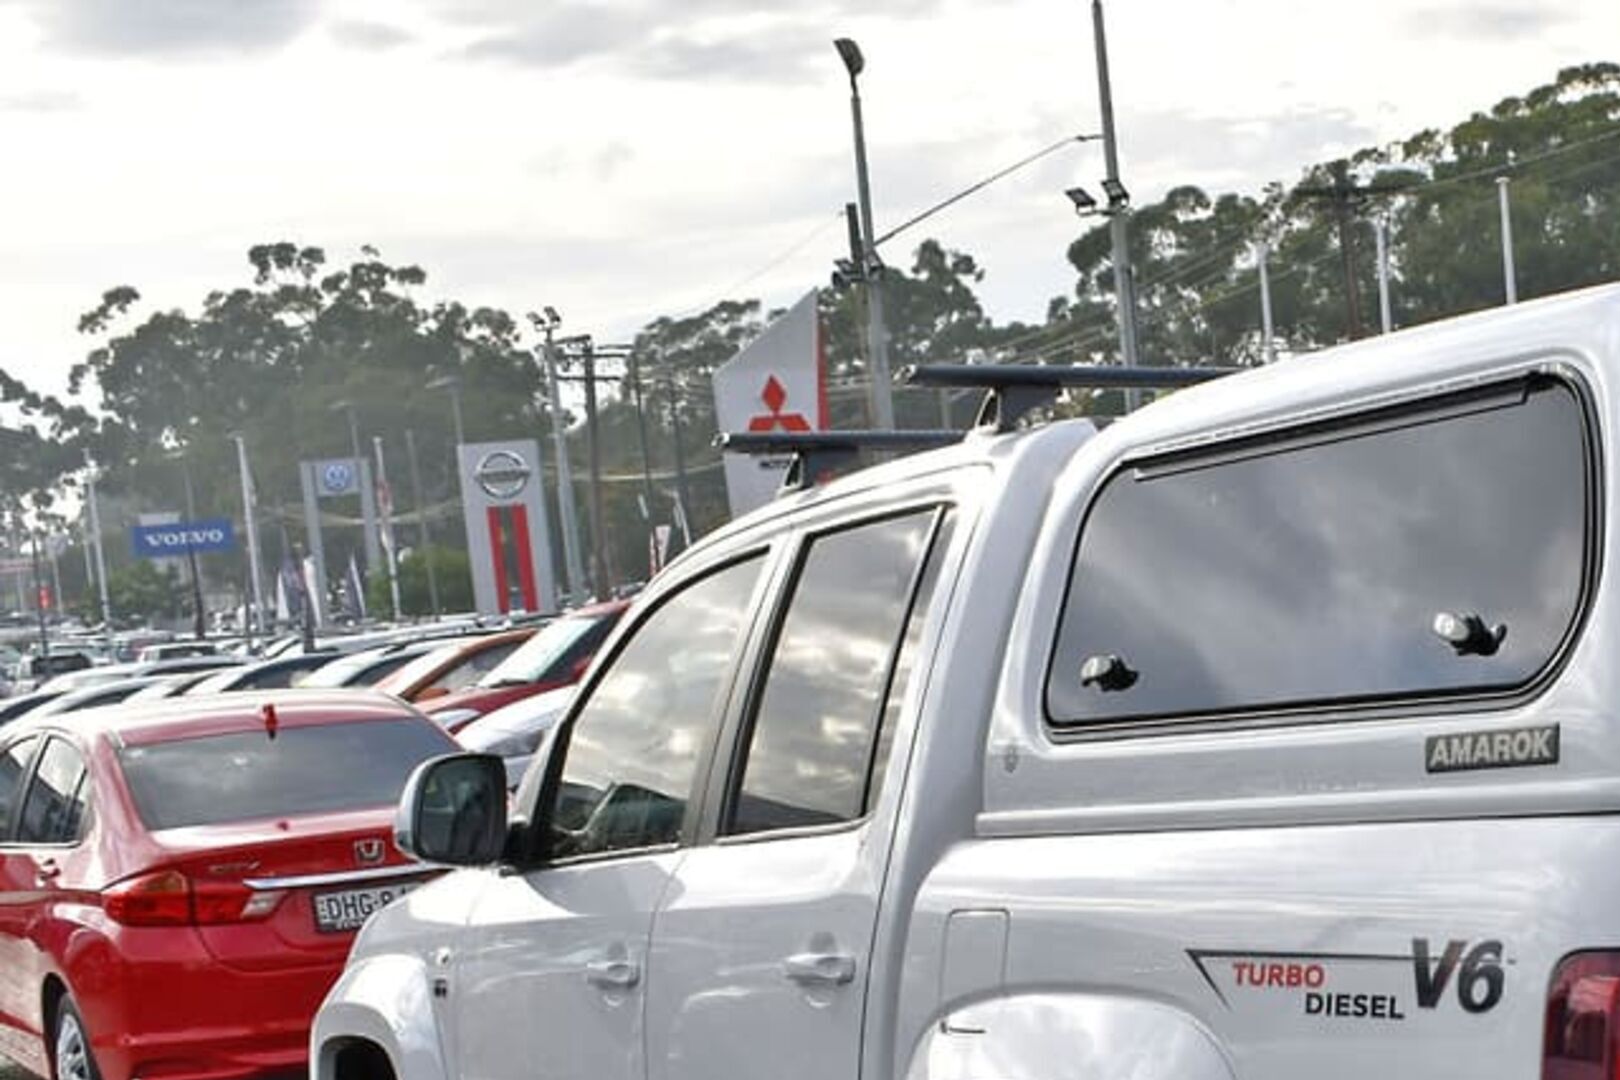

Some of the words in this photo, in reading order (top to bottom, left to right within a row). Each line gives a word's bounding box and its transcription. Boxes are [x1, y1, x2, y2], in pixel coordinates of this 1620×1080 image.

[1429, 728, 1553, 768] AMAROK
[1233, 962, 1325, 988] TURBO
[1411, 937, 1505, 1014] V6
[1305, 992, 1405, 1020] DIESEL
